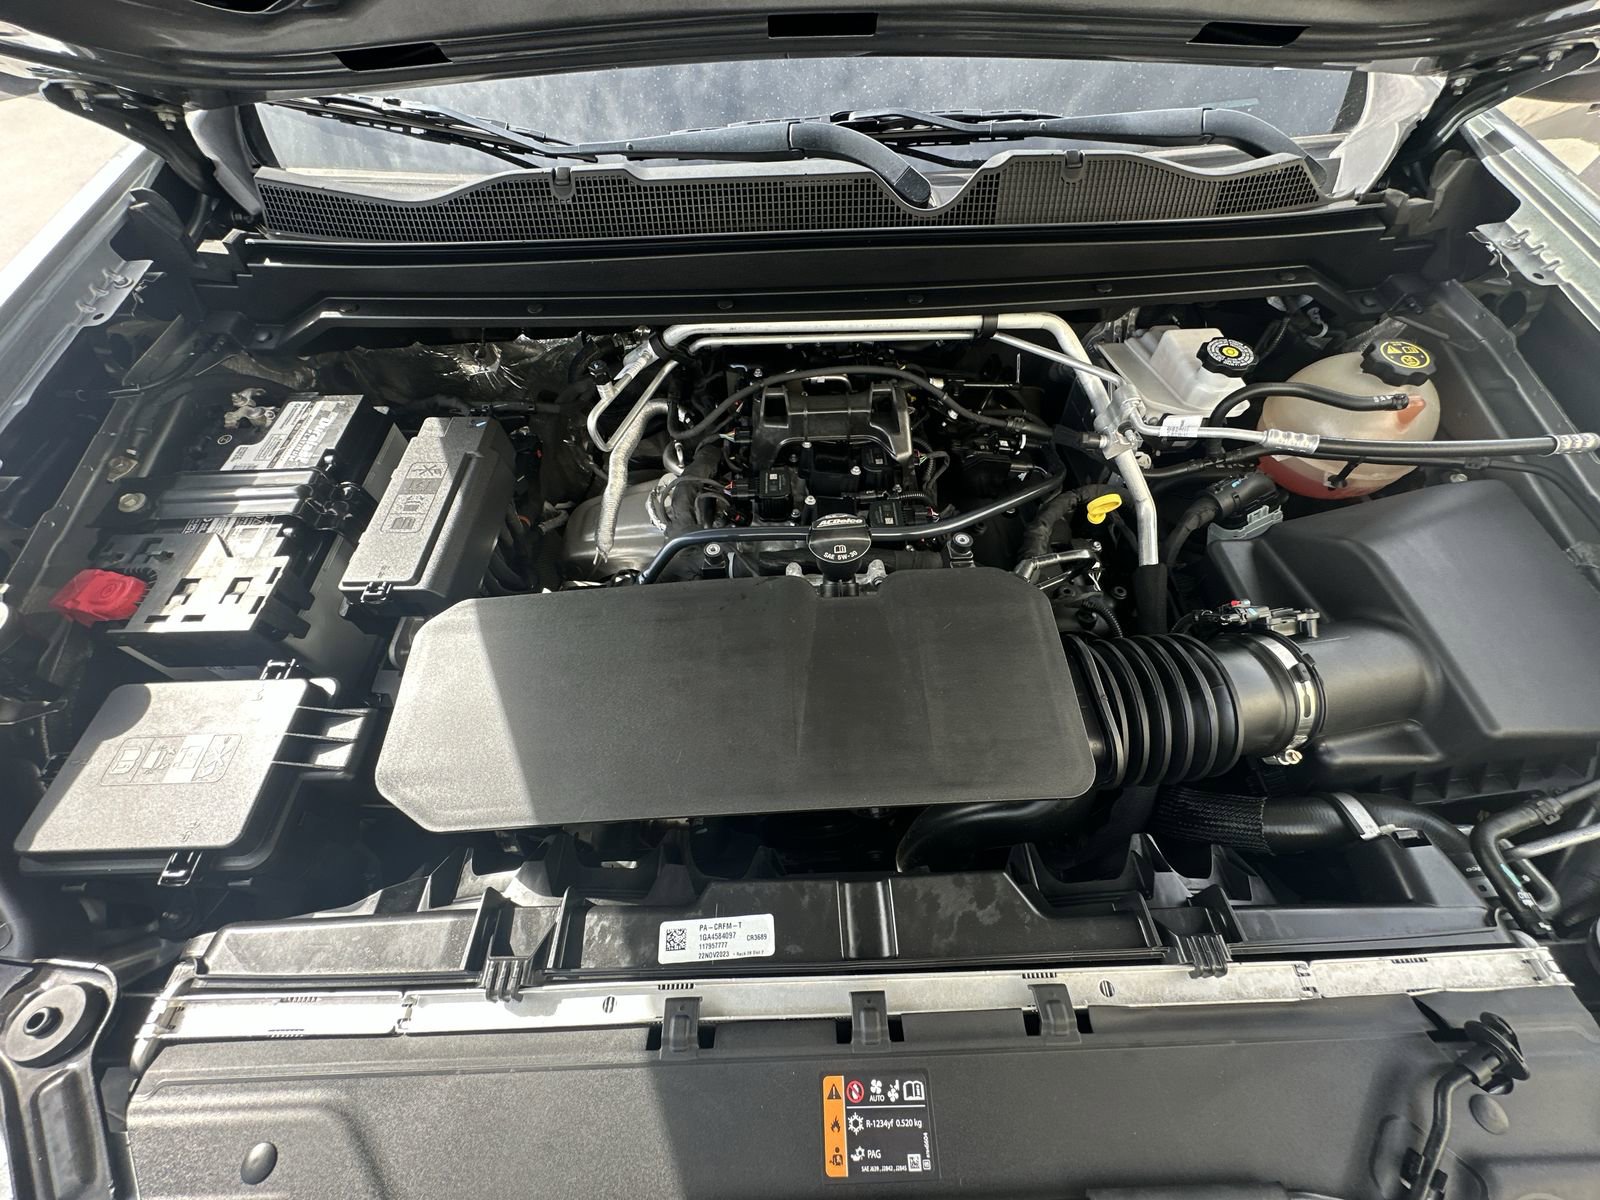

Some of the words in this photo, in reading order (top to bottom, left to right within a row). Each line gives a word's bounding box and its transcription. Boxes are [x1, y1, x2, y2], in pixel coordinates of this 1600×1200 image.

[817, 518, 863, 528] ACDelco
[823, 551, 835, 560] SAE
[837, 550, 858, 560] 5W-30
[699, 931, 736, 941] 1GA4584097
[746, 933, 768, 941] CR3689
[698, 950, 730, 960] 22NOV2023
[865, 1118, 894, 1129] R-1234yf
[895, 1119, 913, 1128] 0.520
[914, 1118, 923, 1129] kg
[867, 1149, 882, 1159] PAG
